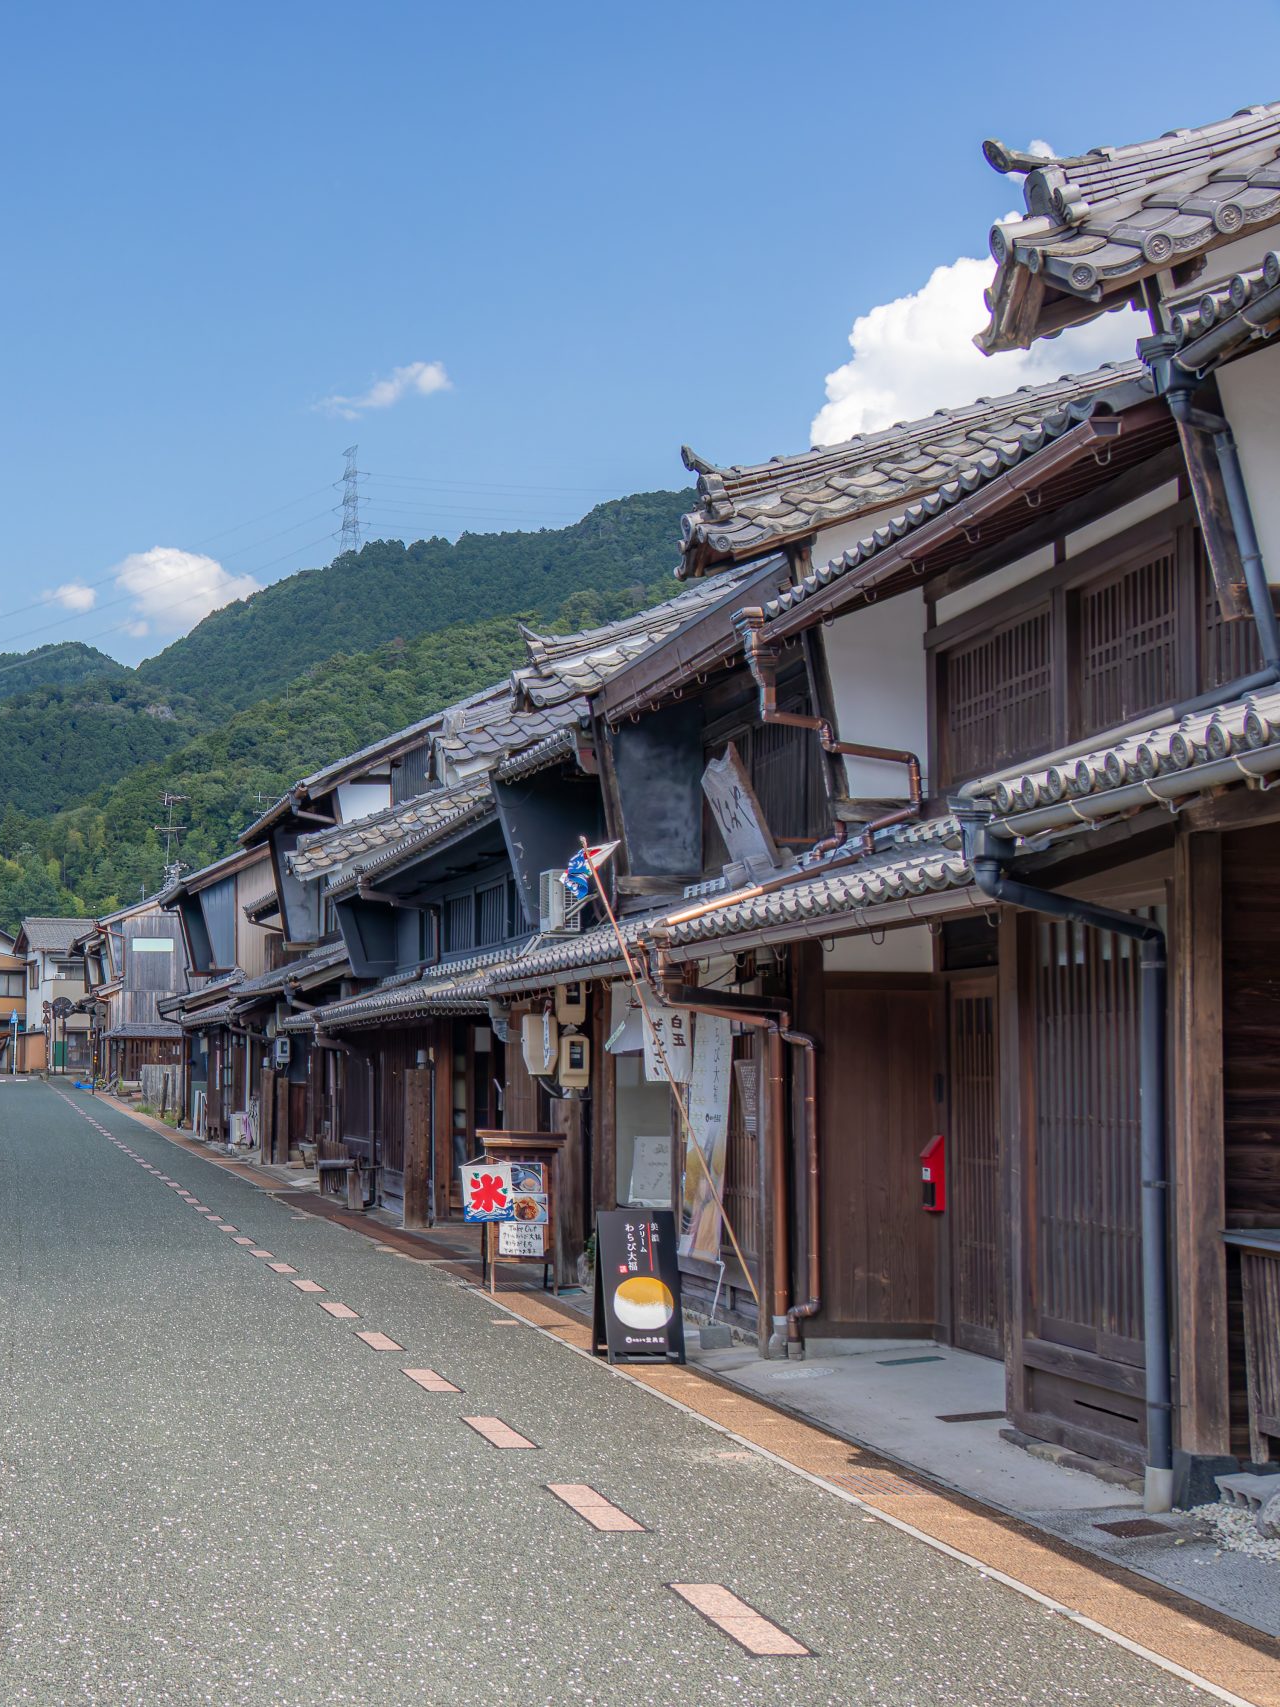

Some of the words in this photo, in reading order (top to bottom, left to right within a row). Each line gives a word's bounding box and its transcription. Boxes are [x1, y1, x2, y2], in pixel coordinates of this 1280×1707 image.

[671, 1014, 687, 1047] 白玉
[470, 1173, 508, 1213] 氷
[624, 1223, 638, 1271] わらび大福
[639, 1223, 648, 1253] クリーム
